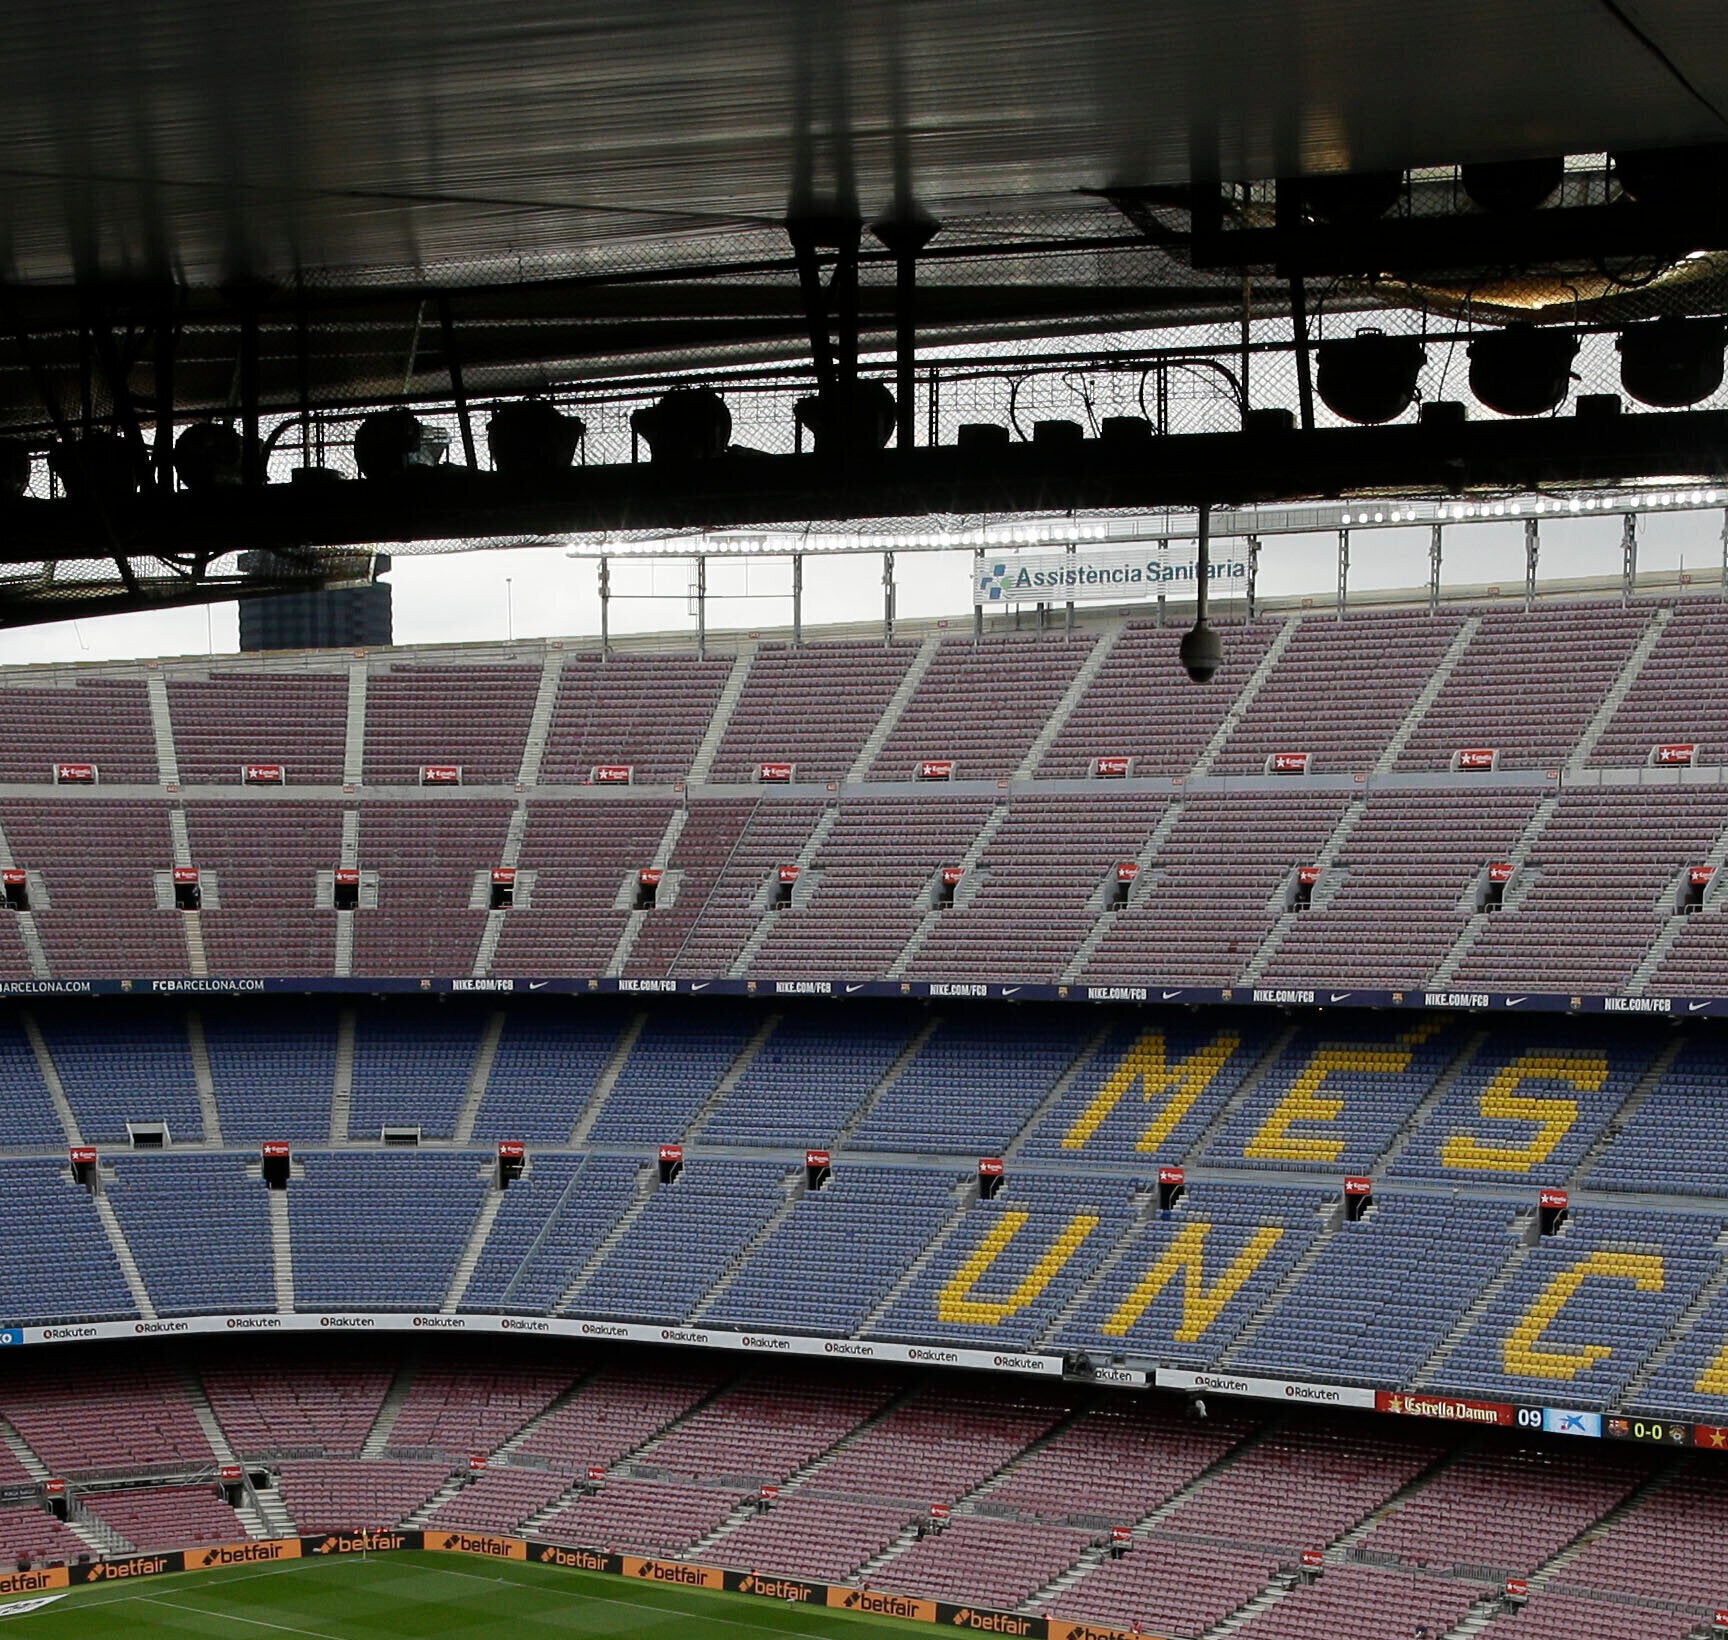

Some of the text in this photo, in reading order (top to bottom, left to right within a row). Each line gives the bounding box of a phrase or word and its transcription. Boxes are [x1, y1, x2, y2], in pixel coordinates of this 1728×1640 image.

[1146, 557, 1245, 583] Saniària
[153, 980, 263, 990] FCBARCELONA.COM
[453, 980, 513, 990] NIKE.COM/FCB
[619, 980, 676, 991] NIKE.COM/FCB
[776, 982, 831, 993] NIKE.COM/FCB
[930, 984, 987, 996] NIKE.COM/FCB
[1088, 988, 1146, 999] NIKE.COM/FCB
[1254, 990, 1314, 1002] NIKE.COM/FCB
[1425, 994, 1488, 1006] NIKE.COM/FCB
[1605, 998, 1670, 1011] NIKE.COM/FCB
[1061, 1018, 1610, 1170] MÉS
[935, 1210, 1284, 1343] UN
[144, 1320, 188, 1332] Rakuten
[236, 1316, 281, 1328] Rakuten
[330, 1316, 374, 1328] Rakuten
[423, 1316, 465, 1328] Rakuten
[511, 1319, 548, 1331] Rakuten
[53, 1325, 97, 1338] Rakuten
[590, 1325, 629, 1338] Rakuten
[670, 1331, 708, 1344] Rakuten
[751, 1338, 790, 1350] Rakuten
[834, 1344, 873, 1356] Rakuten
[918, 1350, 958, 1363] Rakuten
[1003, 1357, 1043, 1370] Rakuten
[1095, 1369, 1131, 1381] akuten
[1204, 1376, 1247, 1391] Rakuten
[1295, 1386, 1339, 1401] Rakuten
[1404, 1397, 1498, 1423] Estrella Damm
[1518, 1409, 1541, 1427] 09
[338, 1532, 406, 1554] betfair
[461, 1536, 512, 1558] betfair
[221, 1543, 283, 1565] betfair
[564, 1548, 608, 1570] betfair
[105, 1557, 167, 1577] betfair
[656, 1562, 707, 1585] betfair
[754, 1578, 812, 1602] betfair
[861, 1594, 920, 1619] betfair
[968, 1612, 1030, 1637] betfair
